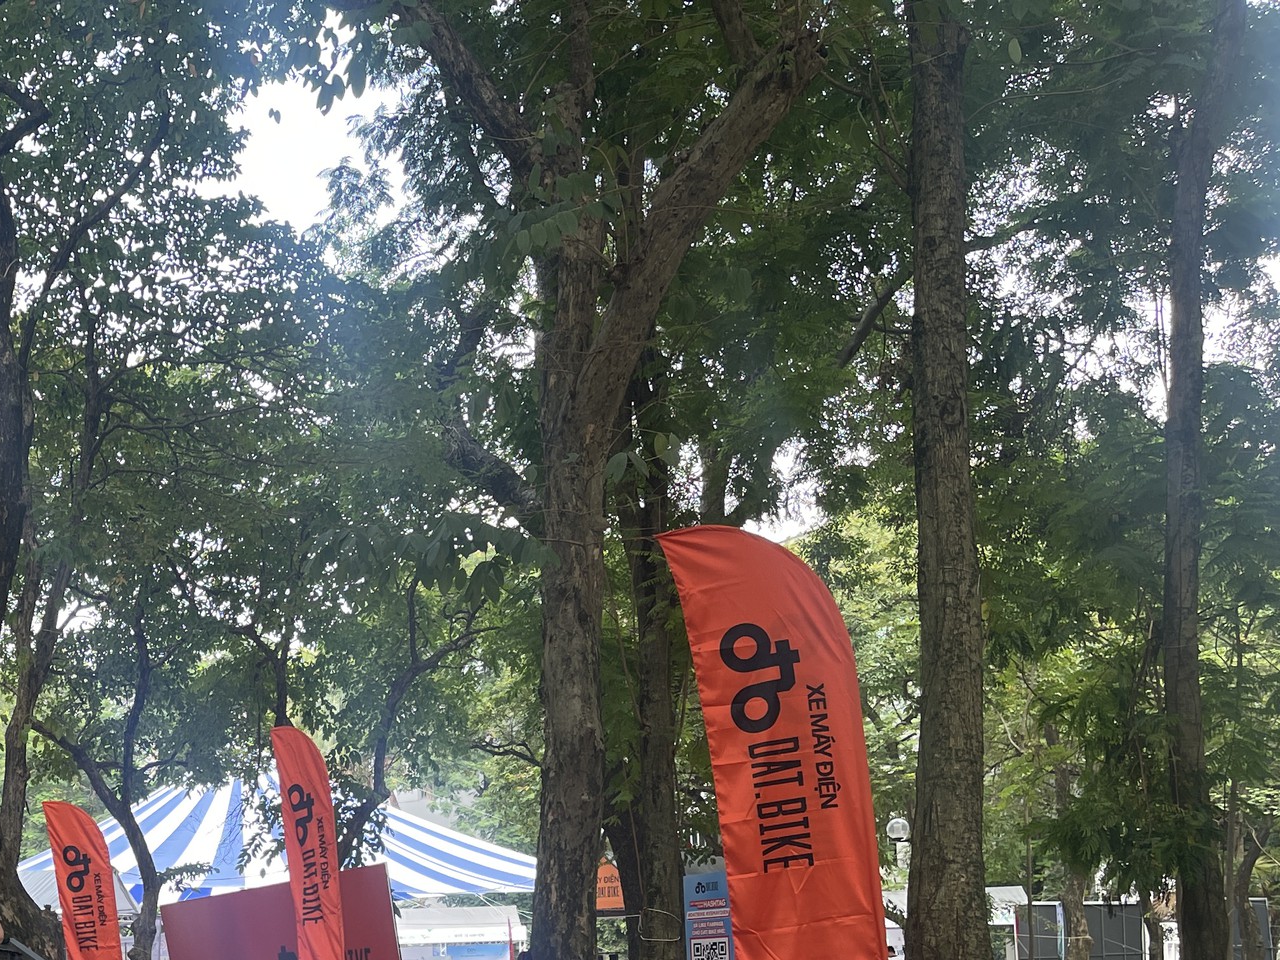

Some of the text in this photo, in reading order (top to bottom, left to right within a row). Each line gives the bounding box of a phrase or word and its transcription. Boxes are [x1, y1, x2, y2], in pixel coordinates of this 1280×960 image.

[806, 683, 842, 810] XE MÁY ĐIỆN
[316, 816, 332, 890] XE MÁY ĐIỆN
[93, 872, 101, 884] XE
[95, 885, 106, 904] MÁY
